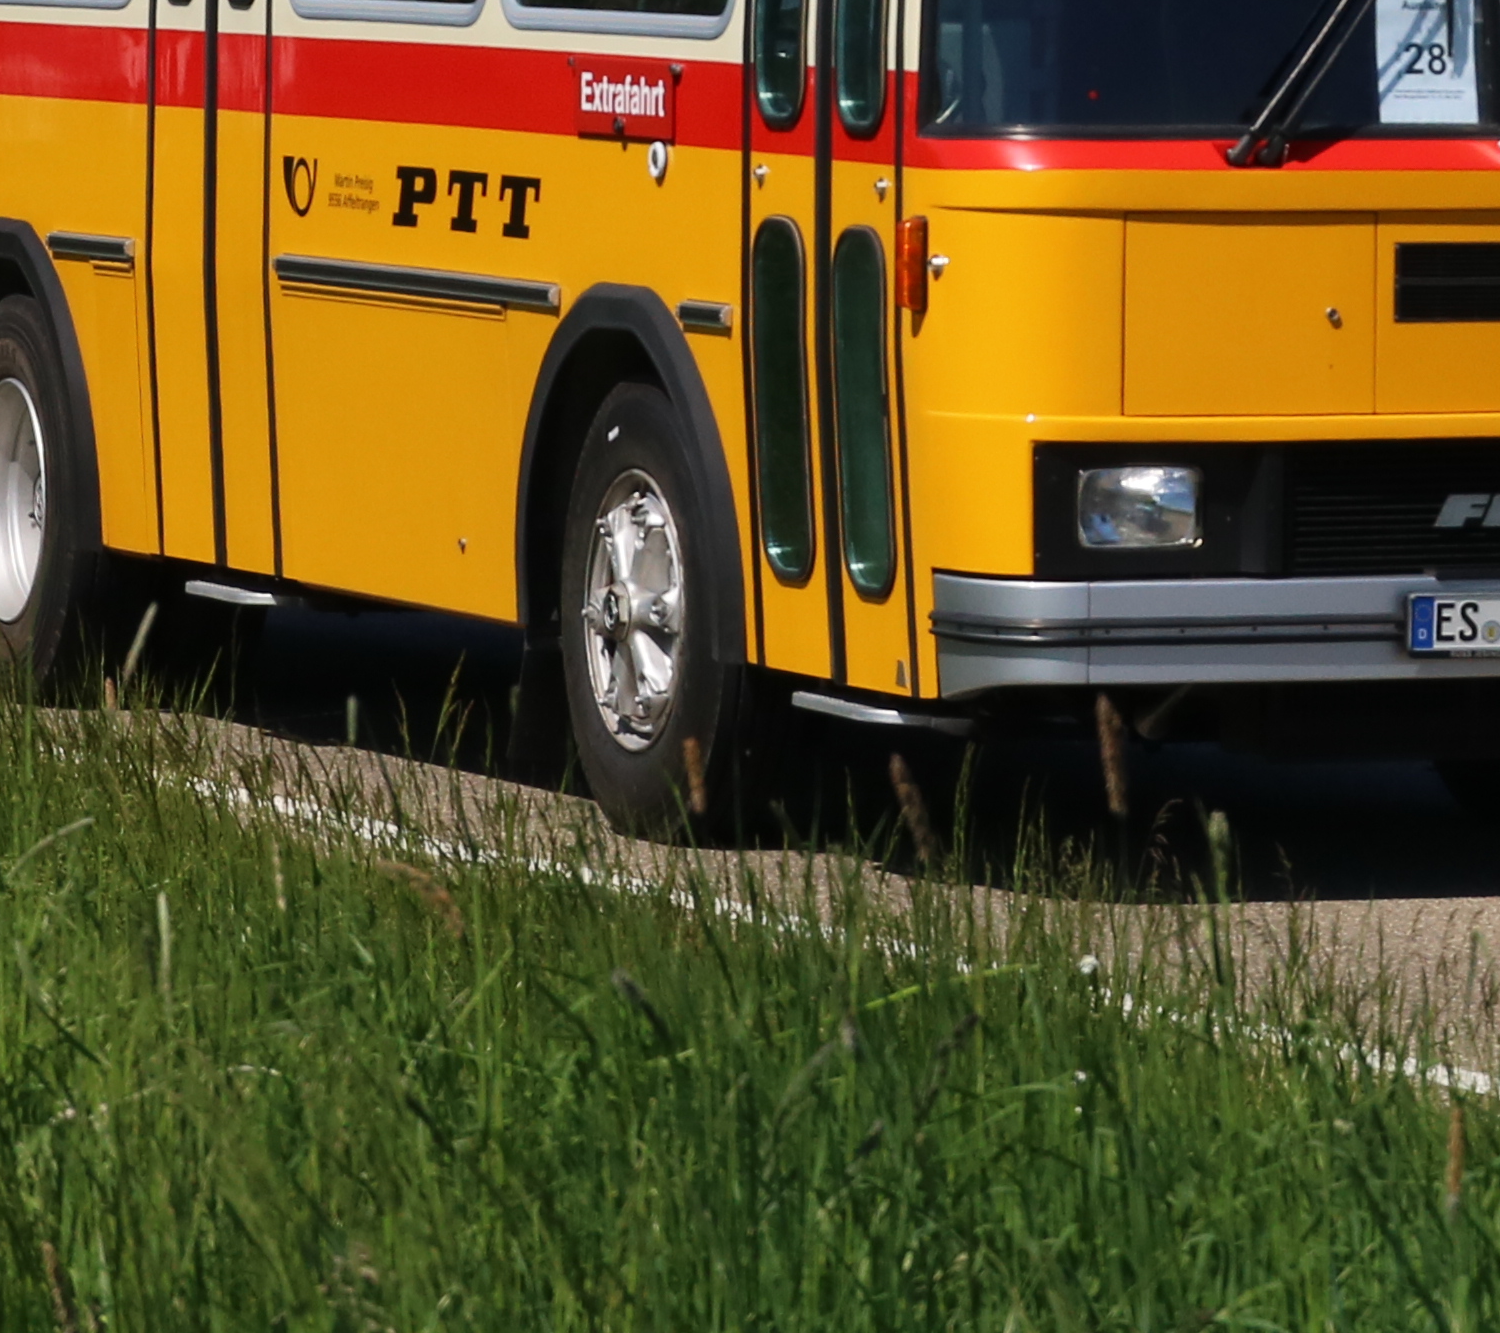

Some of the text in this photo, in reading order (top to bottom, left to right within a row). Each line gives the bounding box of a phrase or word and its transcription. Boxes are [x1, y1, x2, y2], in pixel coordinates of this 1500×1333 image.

[1404, 42, 1447, 76] 28
[581, 71, 665, 118] Extrafahrt
[392, 165, 541, 239] PTT
[1436, 601, 1480, 642] ES
